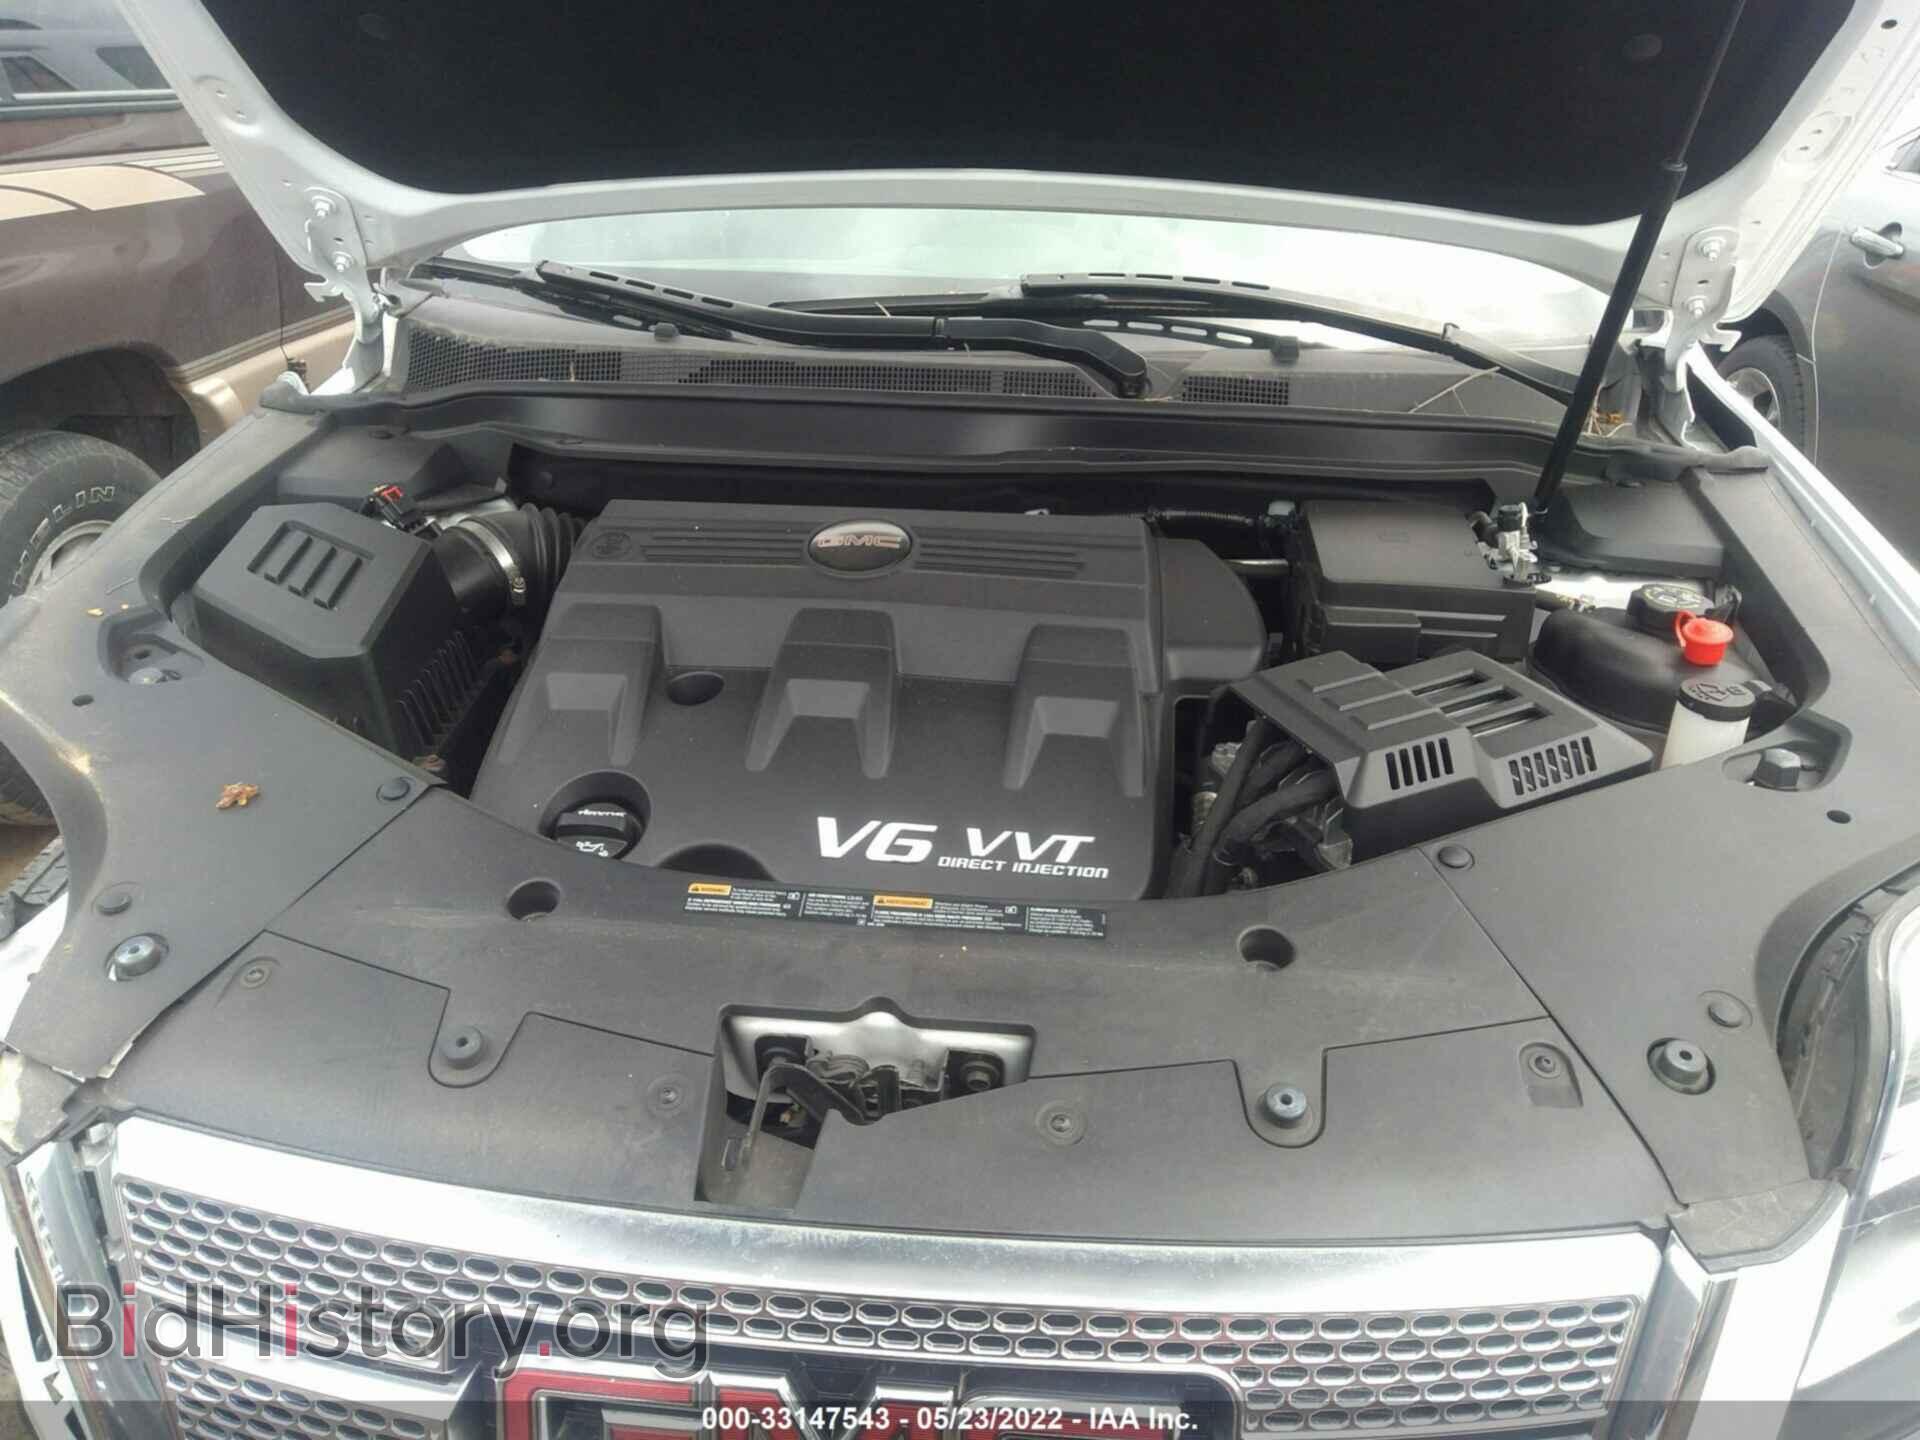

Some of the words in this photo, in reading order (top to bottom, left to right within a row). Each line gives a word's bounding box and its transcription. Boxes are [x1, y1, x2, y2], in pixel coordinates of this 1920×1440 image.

[817, 816, 938, 863] V6
[967, 827, 1095, 863] VVT
[937, 856, 1006, 872] DIRECT
[1012, 862, 1109, 878] INJECTION
